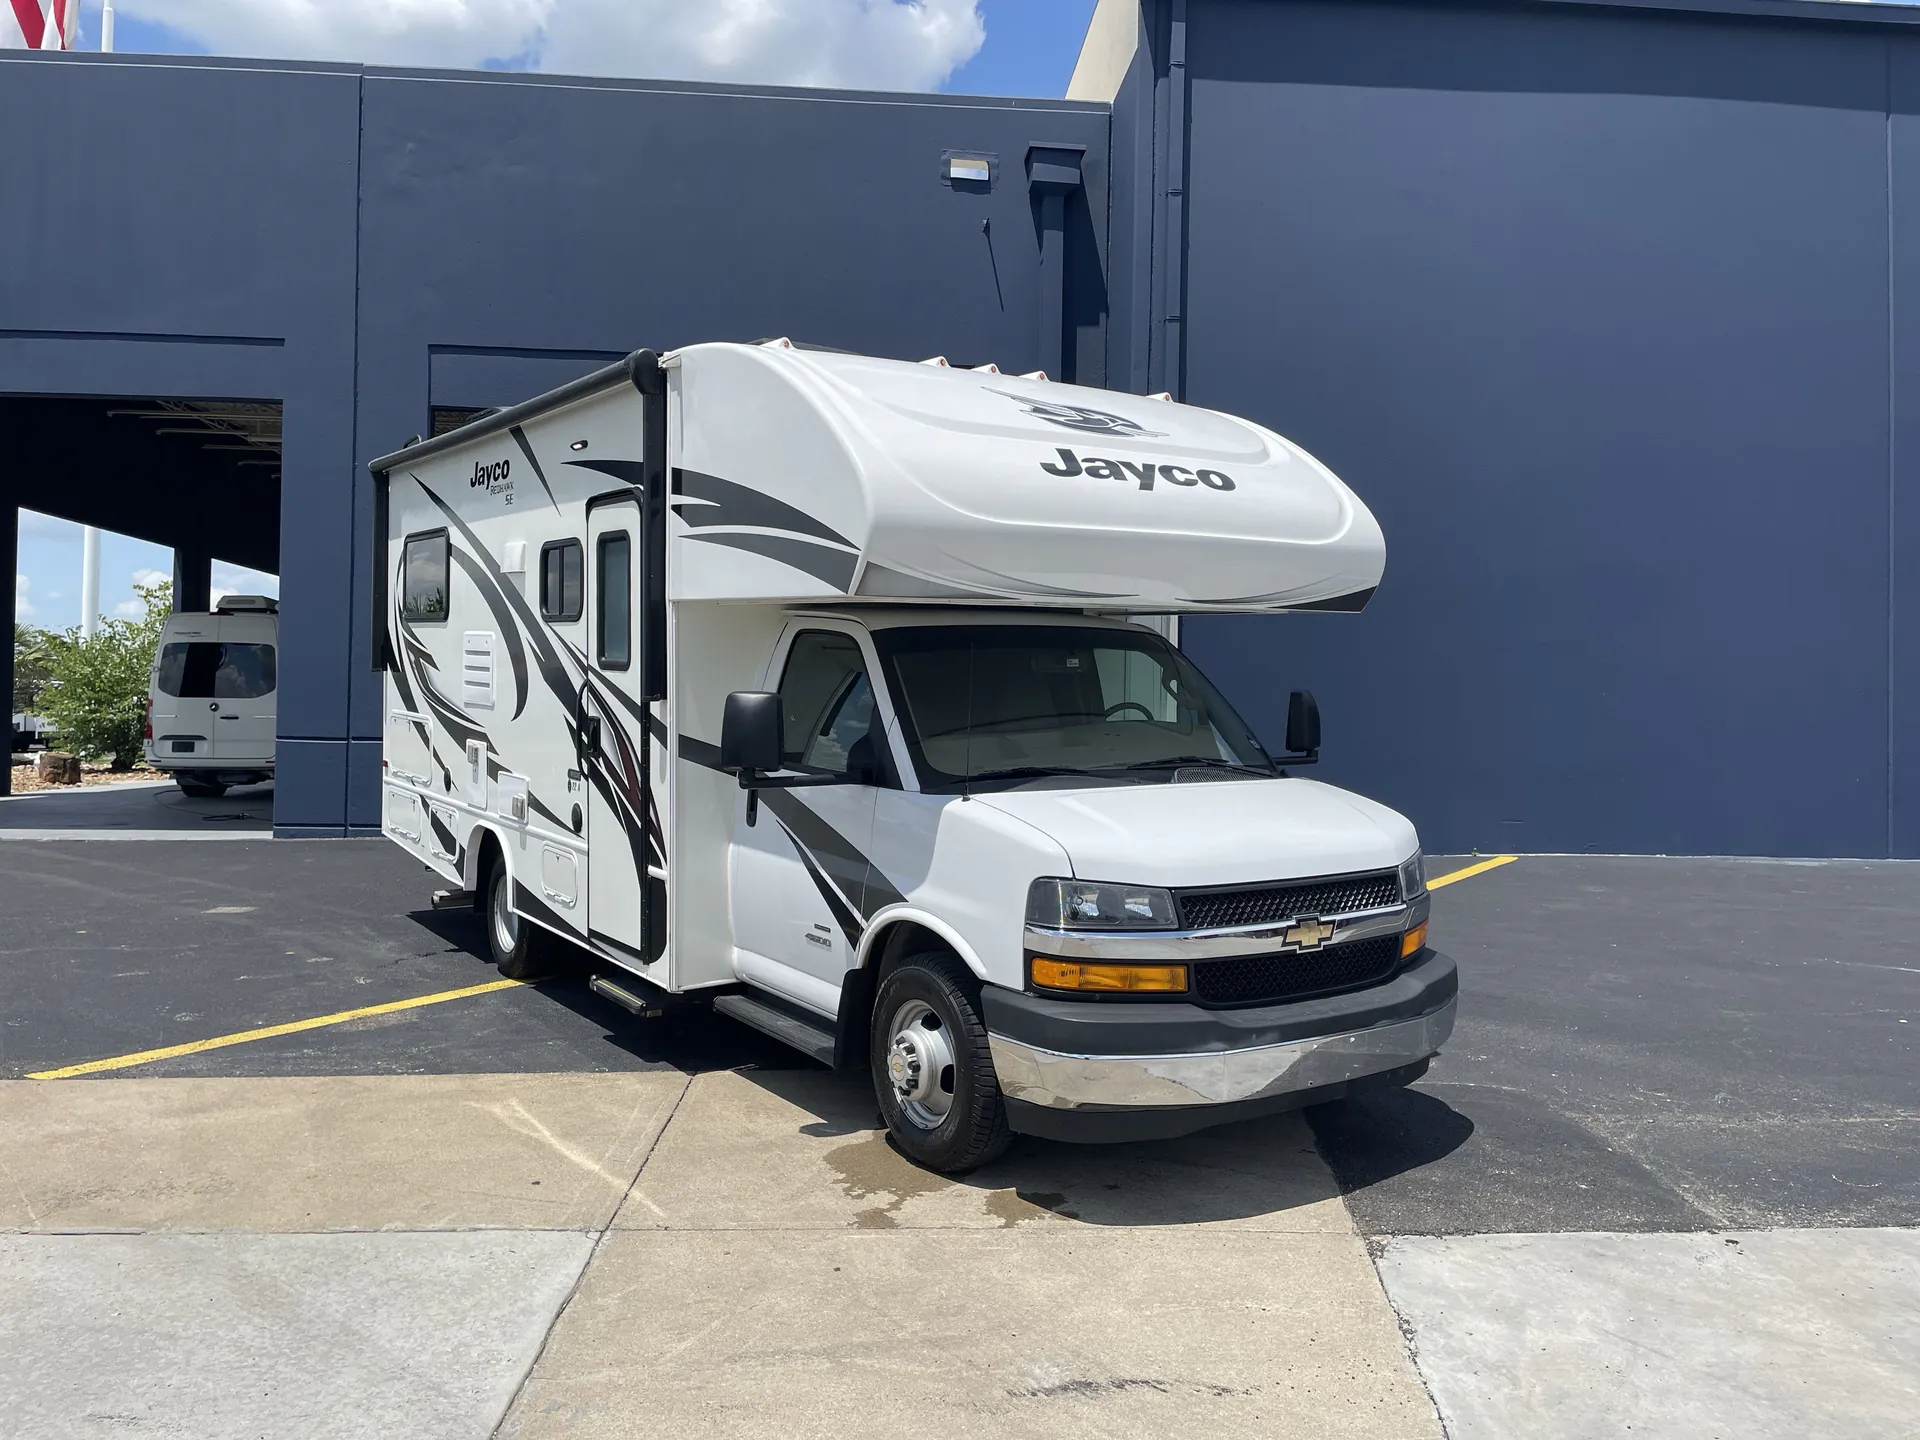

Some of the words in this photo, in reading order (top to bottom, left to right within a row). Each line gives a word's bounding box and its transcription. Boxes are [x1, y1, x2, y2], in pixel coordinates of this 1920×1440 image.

[470, 459, 510, 490] Jayco
[1040, 447, 1236, 491] Jayco
[505, 493, 514, 506] SE
